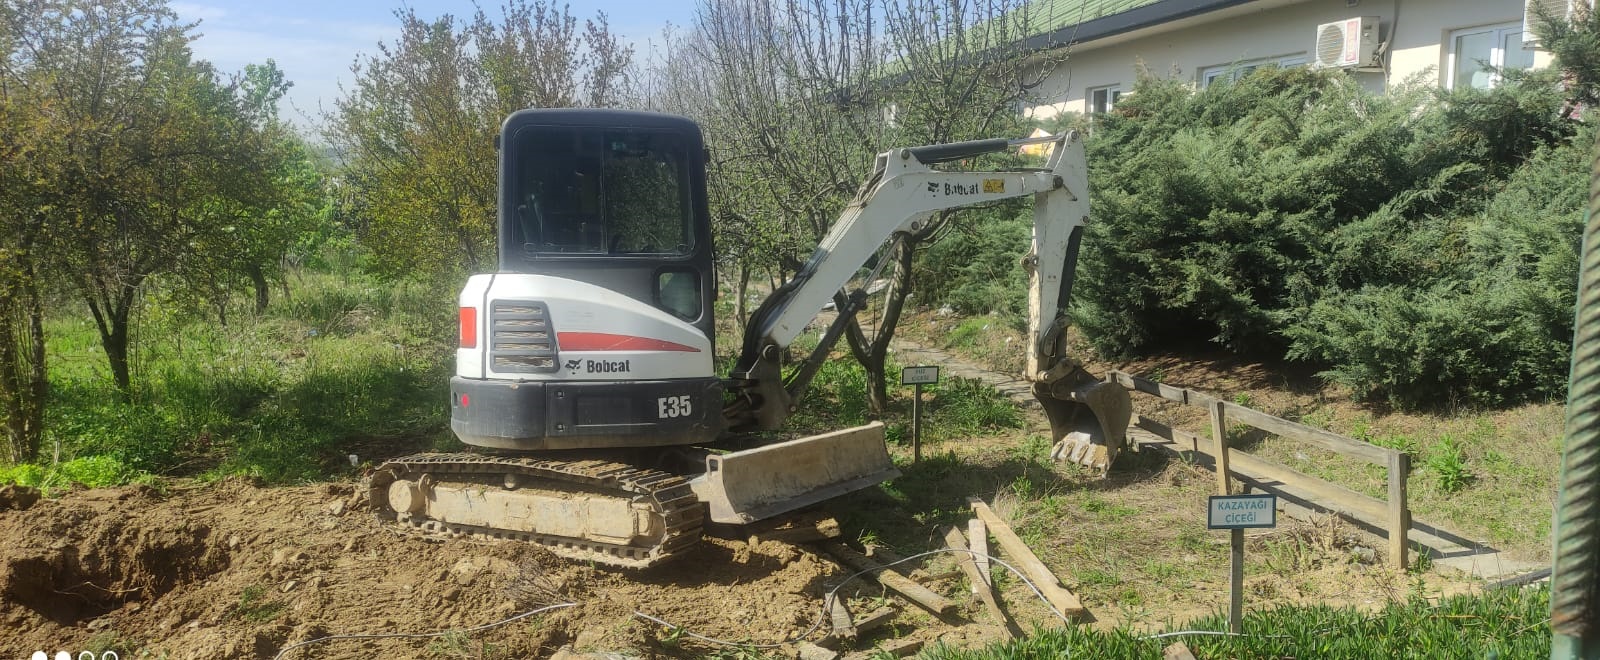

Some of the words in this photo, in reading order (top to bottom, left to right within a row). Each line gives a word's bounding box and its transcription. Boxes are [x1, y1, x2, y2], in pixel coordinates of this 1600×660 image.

[586, 359, 631, 373] Bobcat
[657, 395, 692, 419] E35
[1217, 499, 1268, 510] KAZAYAĞI
[1225, 511, 1257, 523] ÇİÇEĞİ
